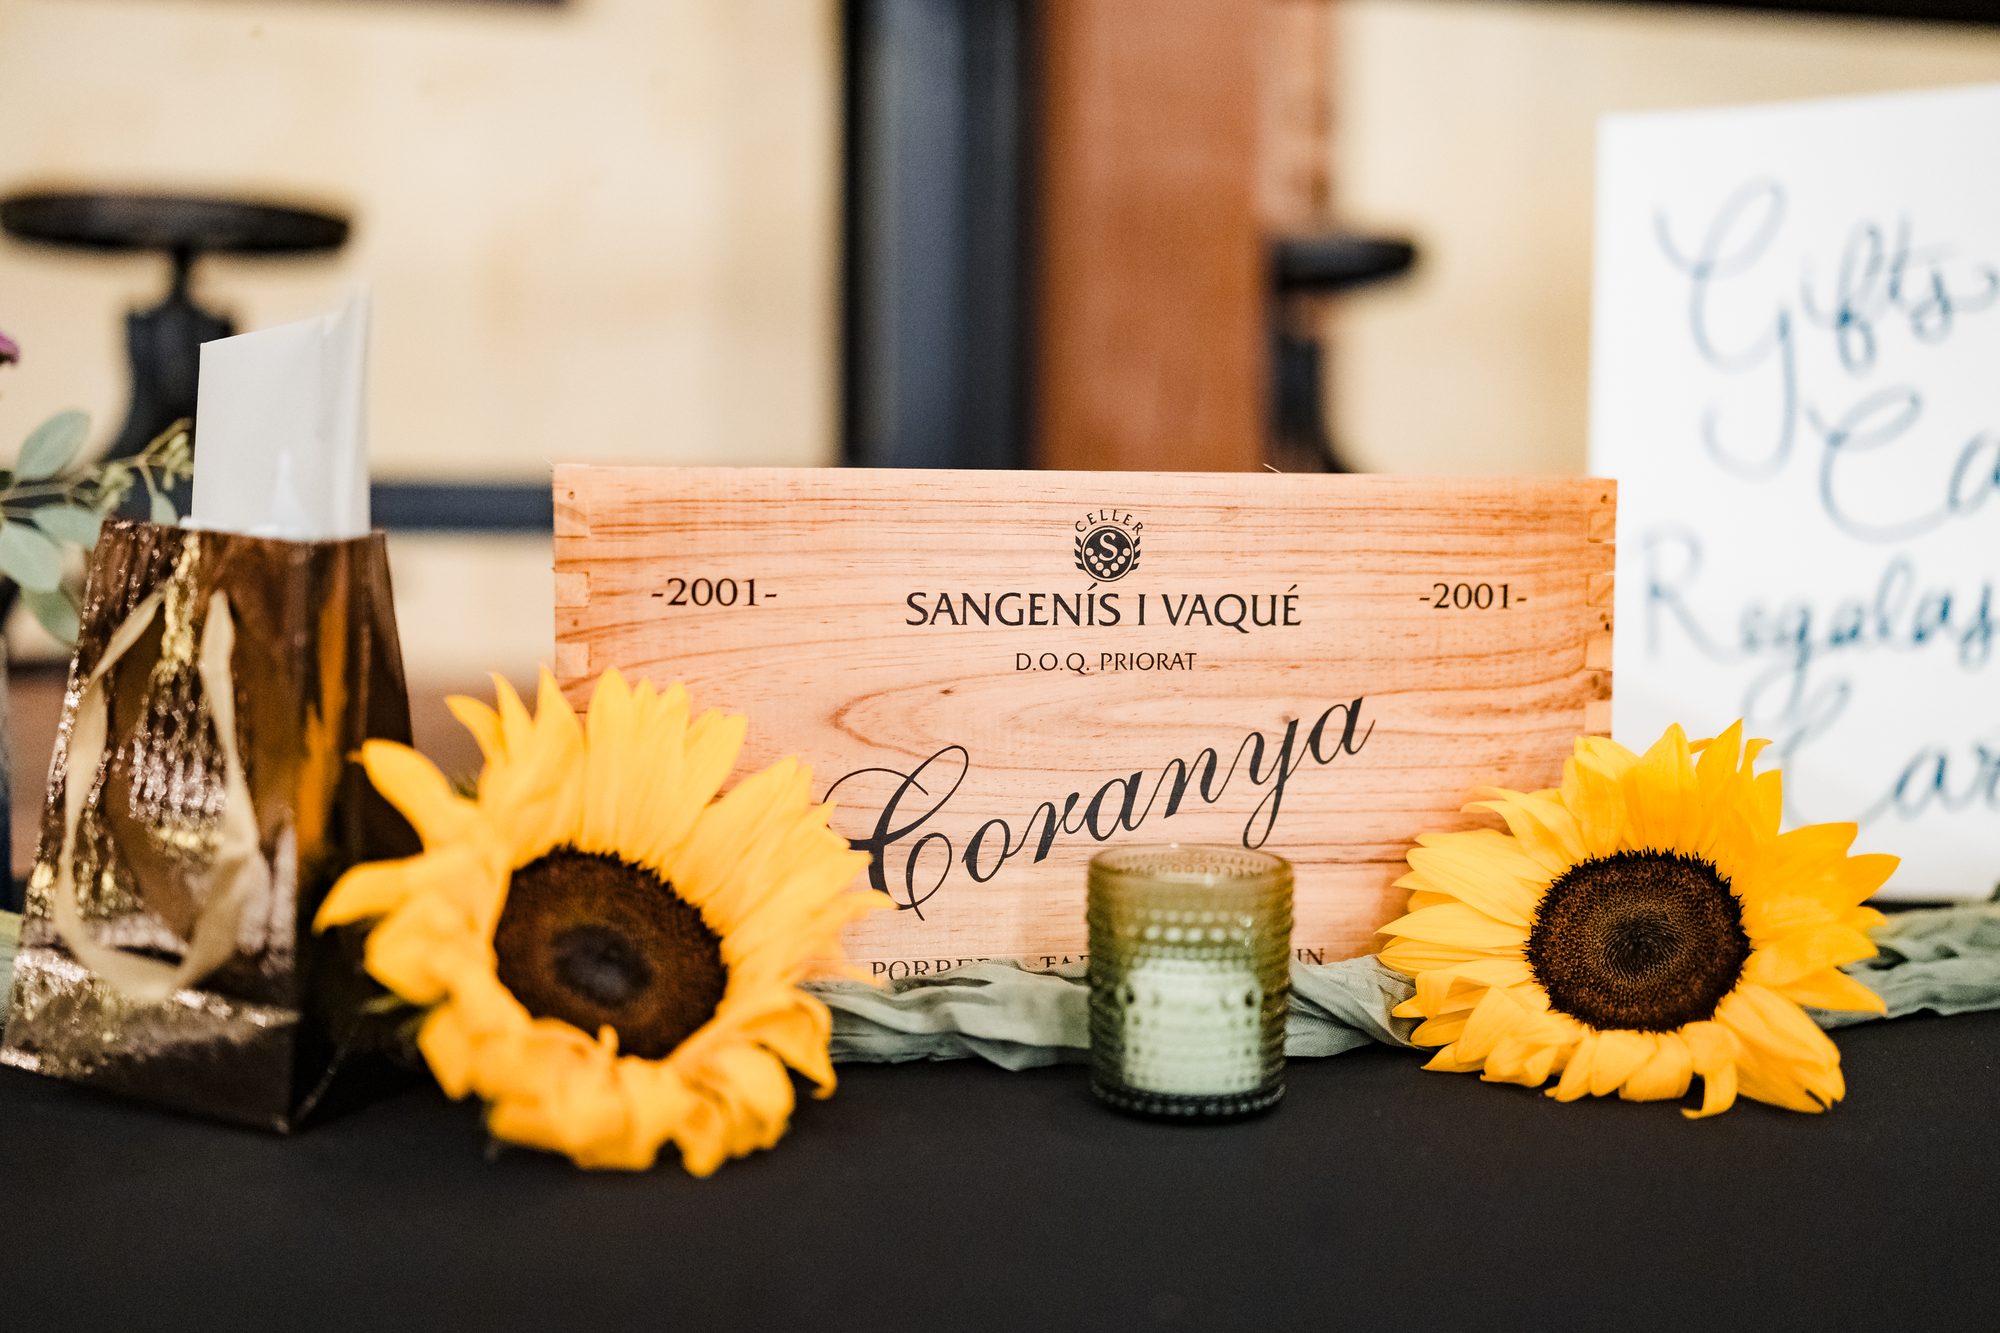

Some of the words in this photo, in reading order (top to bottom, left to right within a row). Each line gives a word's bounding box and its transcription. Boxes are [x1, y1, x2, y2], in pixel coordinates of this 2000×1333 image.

[1074, 508, 1144, 536] CELLER
[1098, 531, 1119, 562] S
[651, 577, 778, 607] -2001-
[1419, 582, 1528, 610] -2001-
[905, 582, 1121, 627] SANGENÍS
[1137, 593, 1146, 626] I
[1161, 583, 1302, 634] VAQUÉ
[1015, 652, 1091, 676] D.O.Q.
[1100, 652, 1197, 671] PRIORAT
[822, 696, 1376, 921] Coranya
